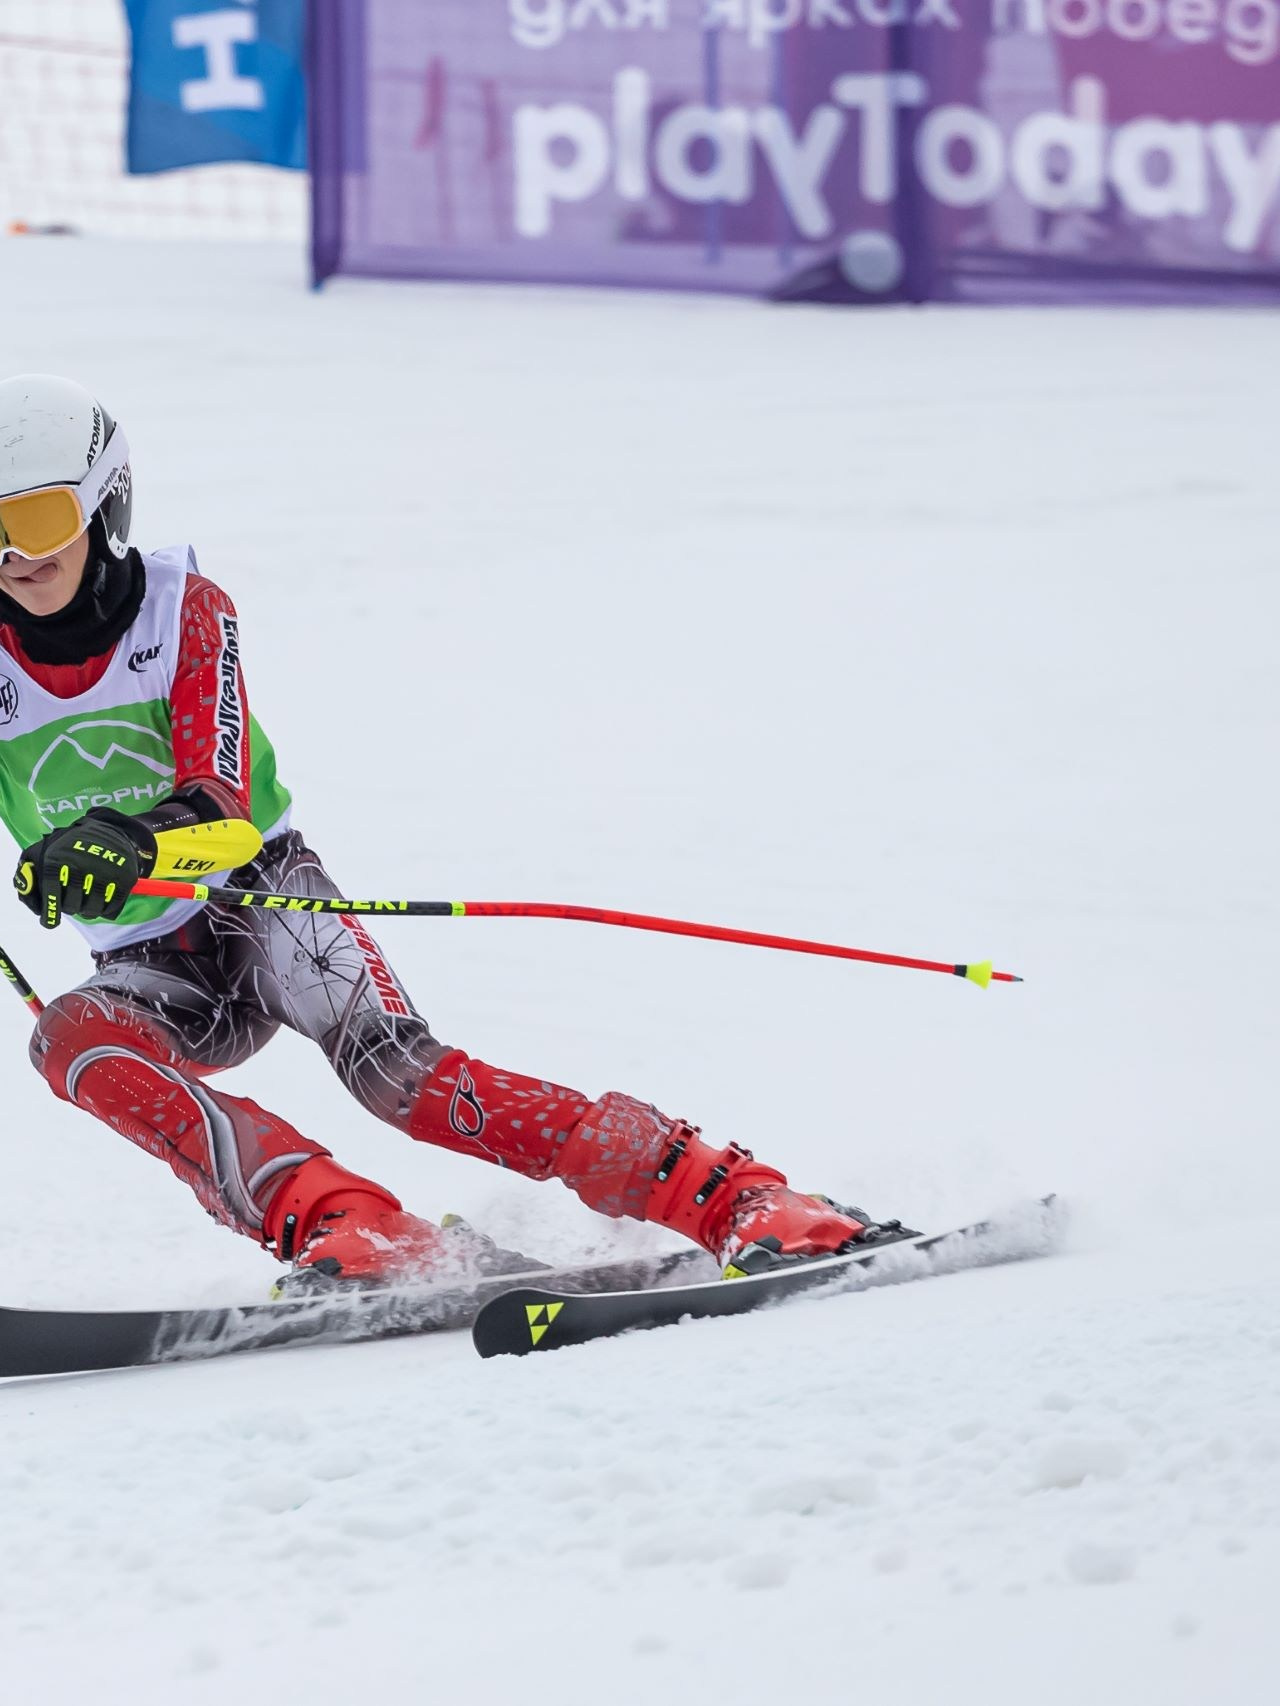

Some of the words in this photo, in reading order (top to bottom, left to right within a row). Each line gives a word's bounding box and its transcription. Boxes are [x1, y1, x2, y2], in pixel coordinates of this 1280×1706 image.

[512, 67, 1280, 252] playToday
[86, 406, 101, 469] ATOMIC
[73, 840, 126, 867] LEKI
[172, 857, 216, 872] LEKI
[47, 894, 57, 926] LEKI
